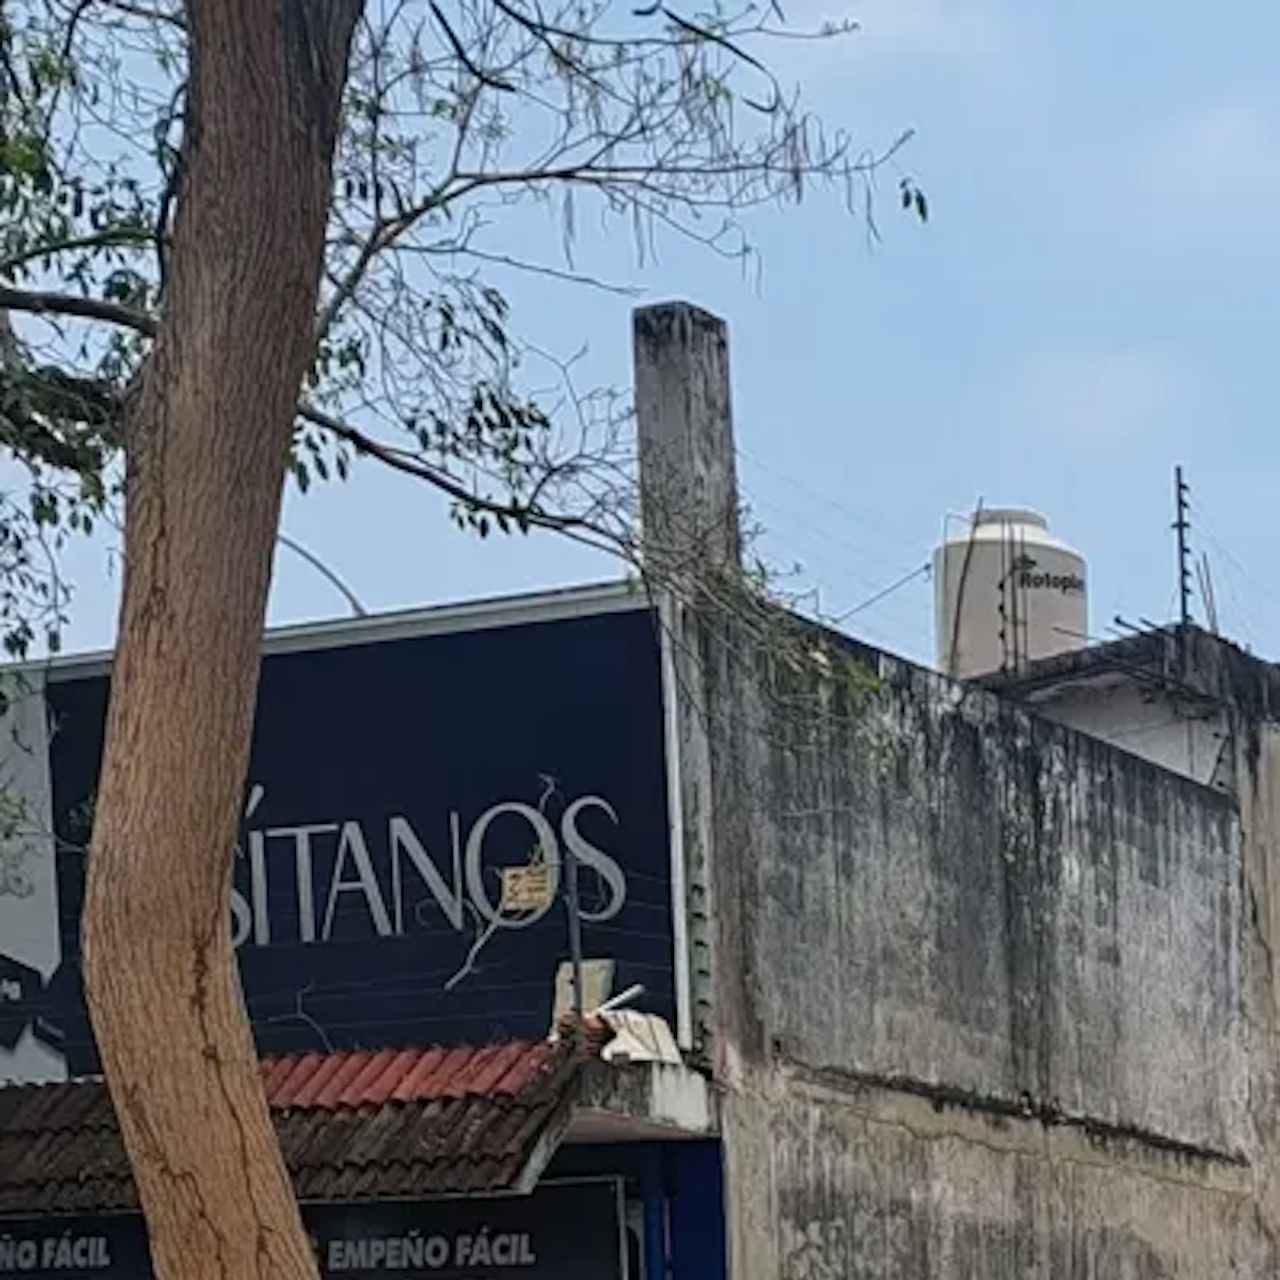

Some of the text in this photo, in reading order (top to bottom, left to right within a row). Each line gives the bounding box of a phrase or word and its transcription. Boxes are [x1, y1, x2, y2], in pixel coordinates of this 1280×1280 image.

[42, 1230, 111, 1269] FÁCIL
[328, 1225, 536, 1271] EMPEÑO FÁCIL
